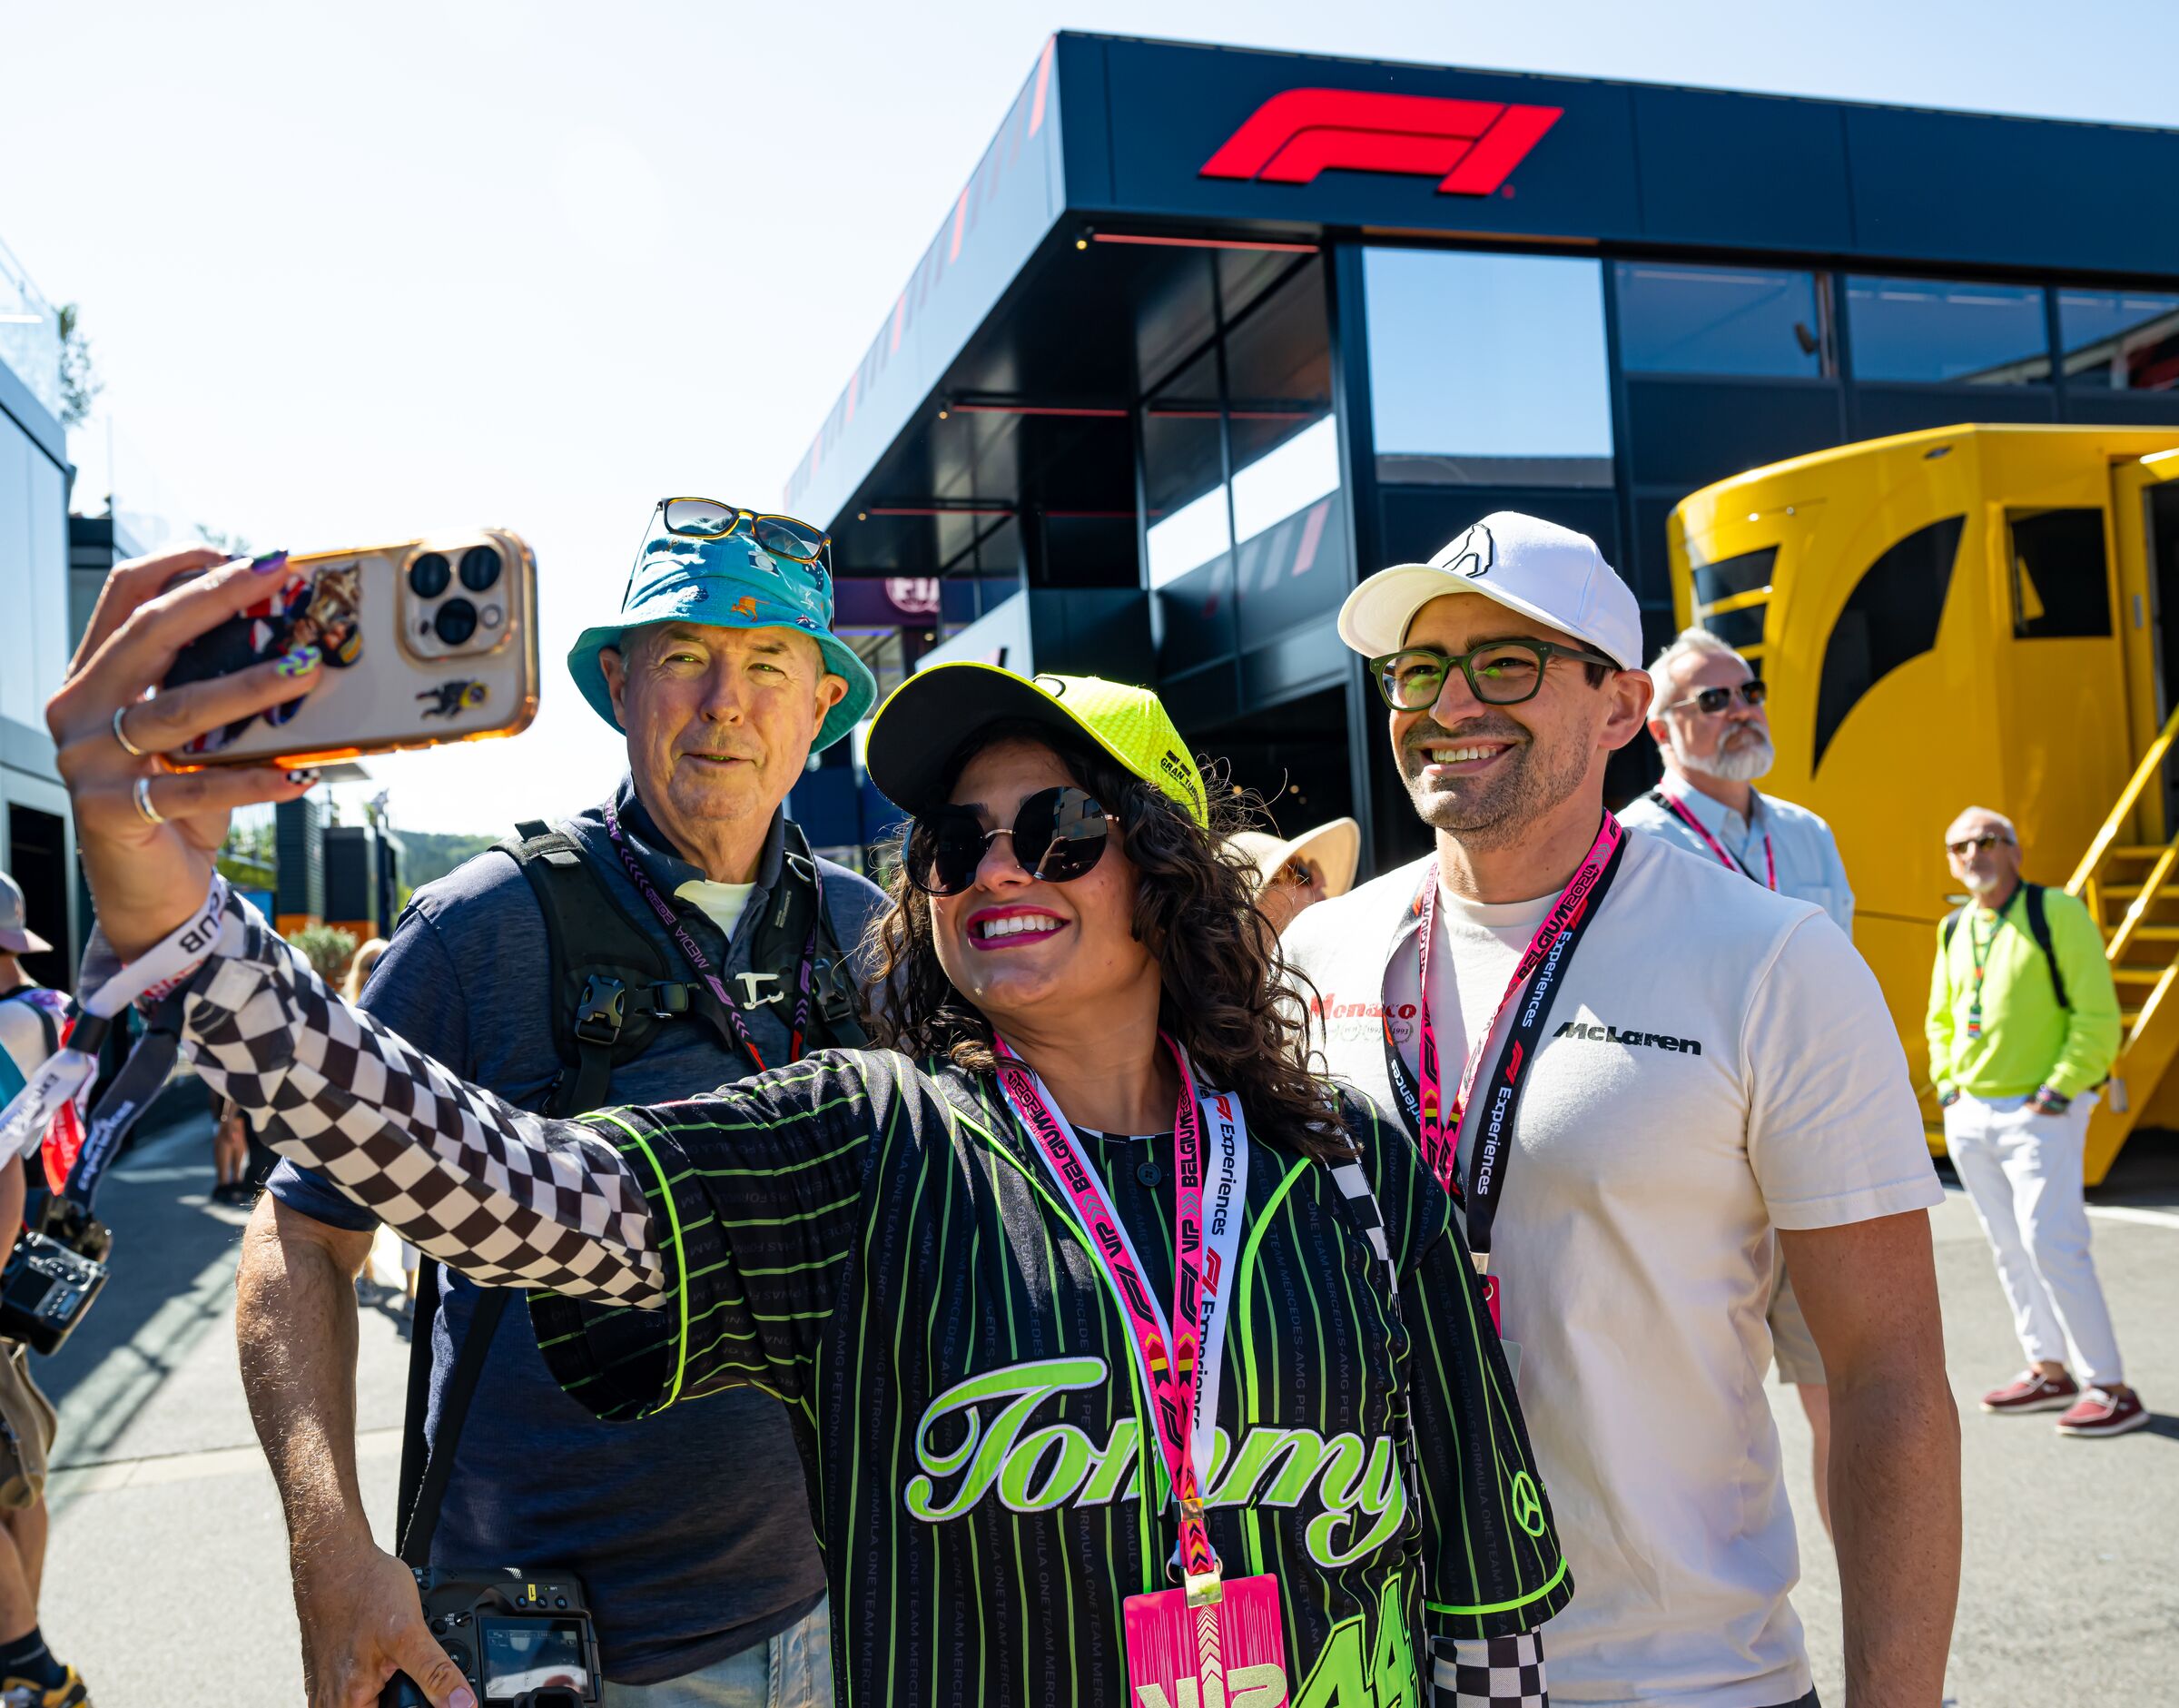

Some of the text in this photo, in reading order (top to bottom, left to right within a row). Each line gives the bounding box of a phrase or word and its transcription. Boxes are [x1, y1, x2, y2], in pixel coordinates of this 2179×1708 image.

[1198, 87, 1564, 195] F1
[1160, 757, 1184, 781] GRAN
[644, 887, 679, 926] 2024
[675, 925, 711, 970] MEDIA
[1522, 930, 1573, 1029] Experiences
[1310, 993, 1416, 1021] Monaco
[1553, 1022, 1702, 1056] McLaren
[1477, 1087, 1513, 1196] Experiences
[892, 1173, 906, 1204] ONE
[1211, 1122, 1237, 1237] Experiences
[883, 1205, 900, 1249] TEAM
[1181, 1219, 1200, 1255] VIP
[1306, 1200, 1322, 1233] ONE
[1095, 1220, 1124, 1259] VIP
[1311, 1232, 1330, 1267] TEAM
[1268, 1233, 1287, 1268] TEAM
[1278, 1269, 1306, 1389] MERCEDES-AMG
[1323, 1268, 1350, 1389] MERCEDES-AMG
[1414, 1358, 1439, 1433] PETRONAS
[1453, 1350, 1477, 1431] PETRONAS
[904, 1356, 1409, 1568] Tommy
[1468, 1434, 1490, 1505] FORMULA
[1481, 1509, 1496, 1541] ONE
[867, 1550, 880, 1586] ONE
[909, 1550, 920, 1585] ONE
[992, 1564, 1007, 1598] ONE
[1488, 1540, 1505, 1583] TEAM
[1039, 1571, 1051, 1606] ONE
[1085, 1579, 1099, 1611] ONE
[863, 1587, 877, 1635] TEAM
[909, 1587, 920, 1636] TEAM
[952, 1589, 966, 1636] TEAM
[995, 1599, 1009, 1646] TEAM
[1041, 1608, 1055, 1652] TEAM
[1090, 1612, 1104, 1657] TEAM
[1289, 1572, 1418, 1708] 44
